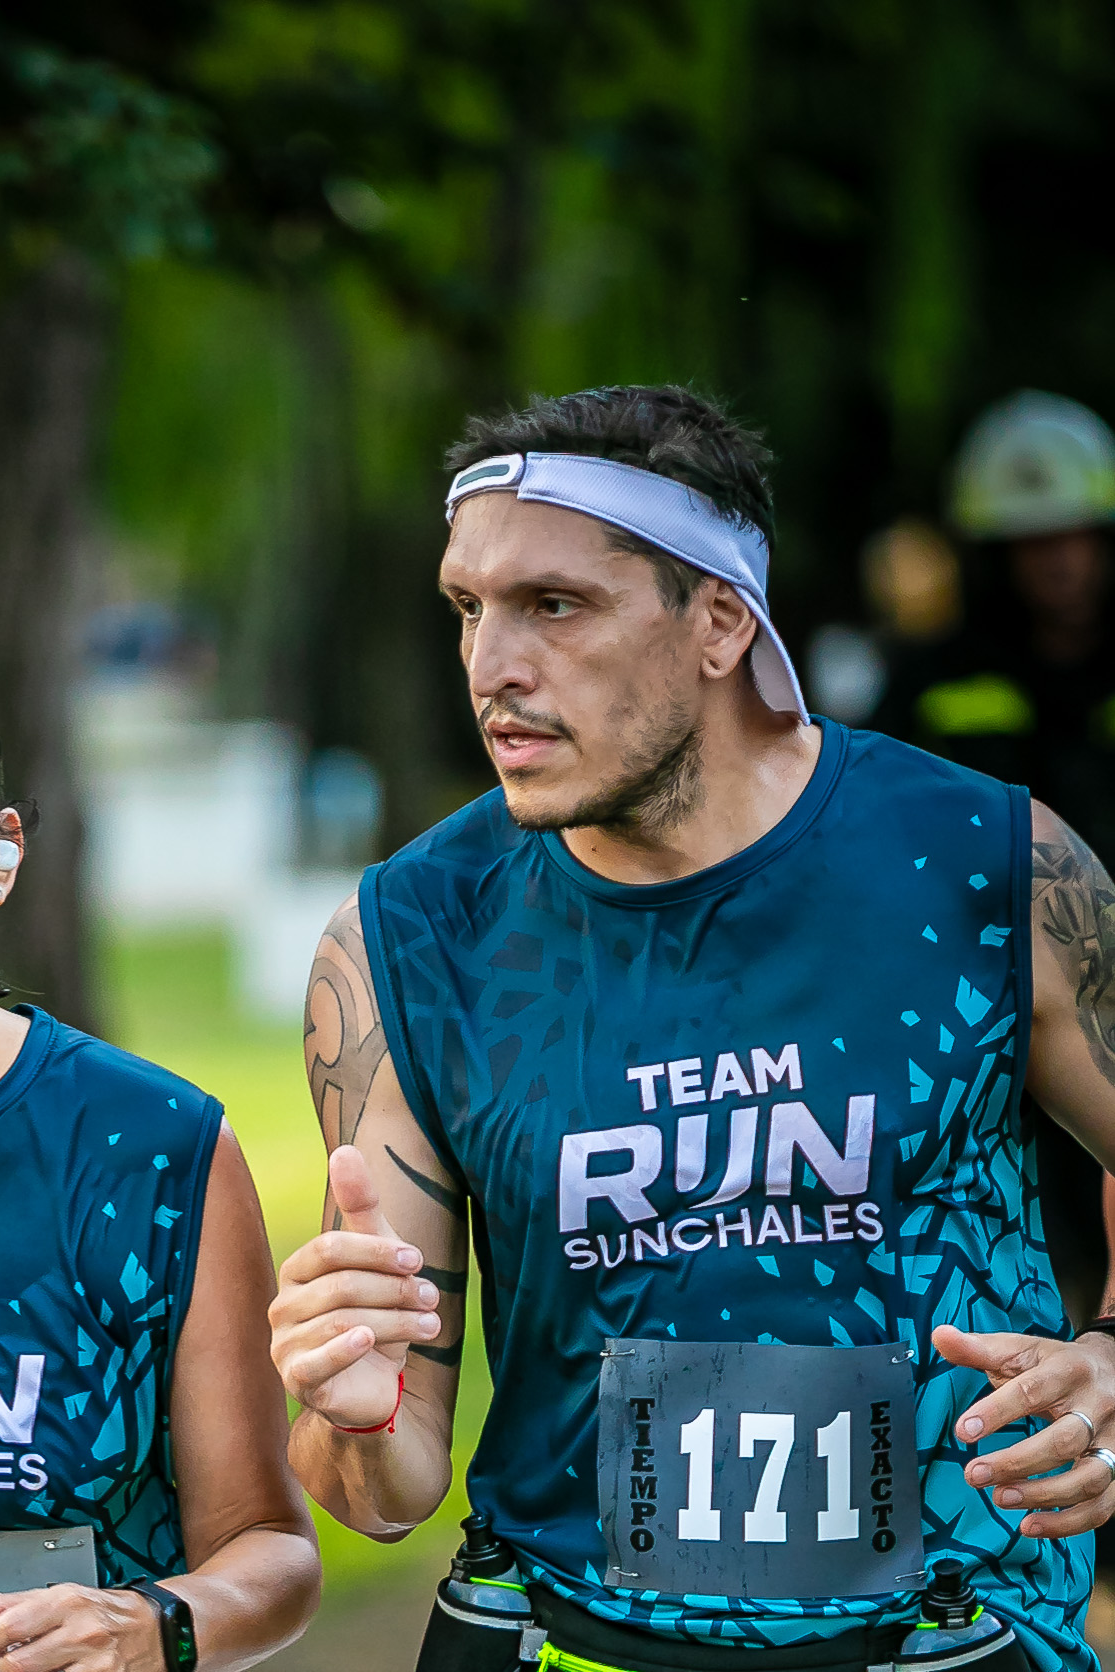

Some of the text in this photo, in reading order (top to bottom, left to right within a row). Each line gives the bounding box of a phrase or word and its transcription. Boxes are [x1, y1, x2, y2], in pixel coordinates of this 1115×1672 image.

[626, 1043, 804, 1112] TEAM
[558, 1093, 876, 1235] RUN
[563, 1201, 884, 1271] SUNCHALES
[629, 1397, 658, 1553] TIEMPO
[678, 1408, 860, 1543] 171
[870, 1400, 897, 1554] EXACTO
